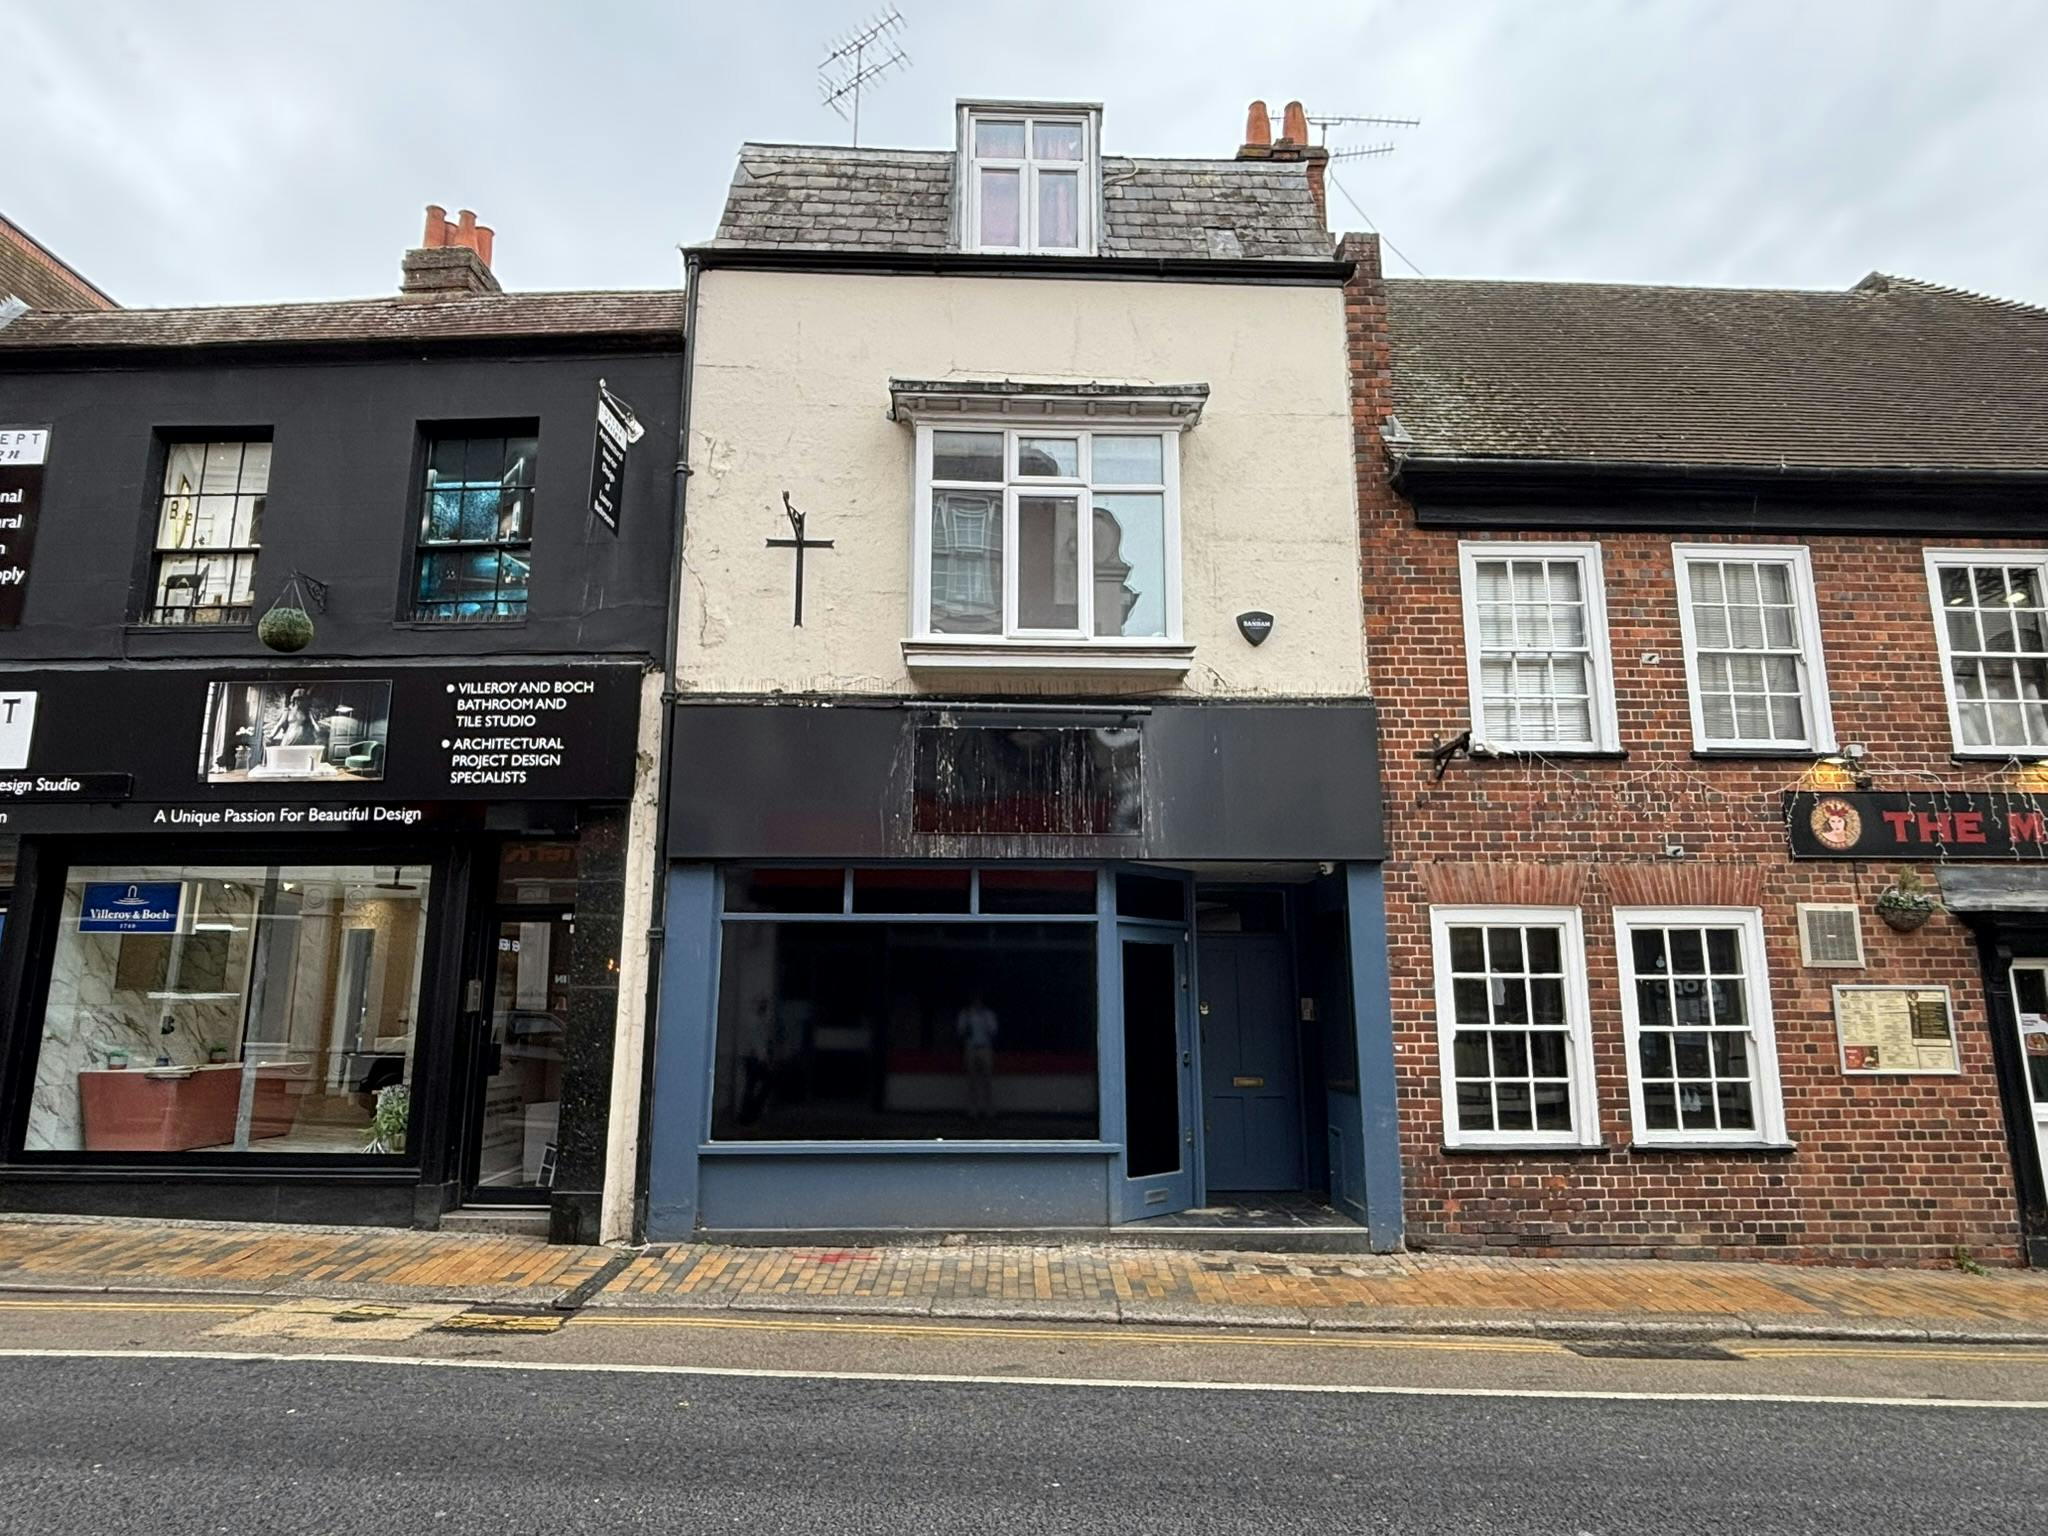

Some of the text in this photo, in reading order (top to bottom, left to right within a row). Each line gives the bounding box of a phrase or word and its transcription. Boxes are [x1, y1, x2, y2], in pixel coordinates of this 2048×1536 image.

[458, 681, 594, 694] VILLEROY AND BOCH
[457, 698, 567, 711] BATHROOM AND
[456, 715, 536, 727] TILE STUDIO
[453, 738, 564, 750] ARCHITECTURAL
[452, 754, 561, 770] PROJECT DESIGN
[36, 777, 80, 791] Studio
[450, 771, 527, 784] SPECIALISTS
[154, 806, 422, 827] A Unique Passion For Beautiful Design
[1882, 811, 1987, 844] THE
[90, 908, 169, 921] Villeroy & Boch
